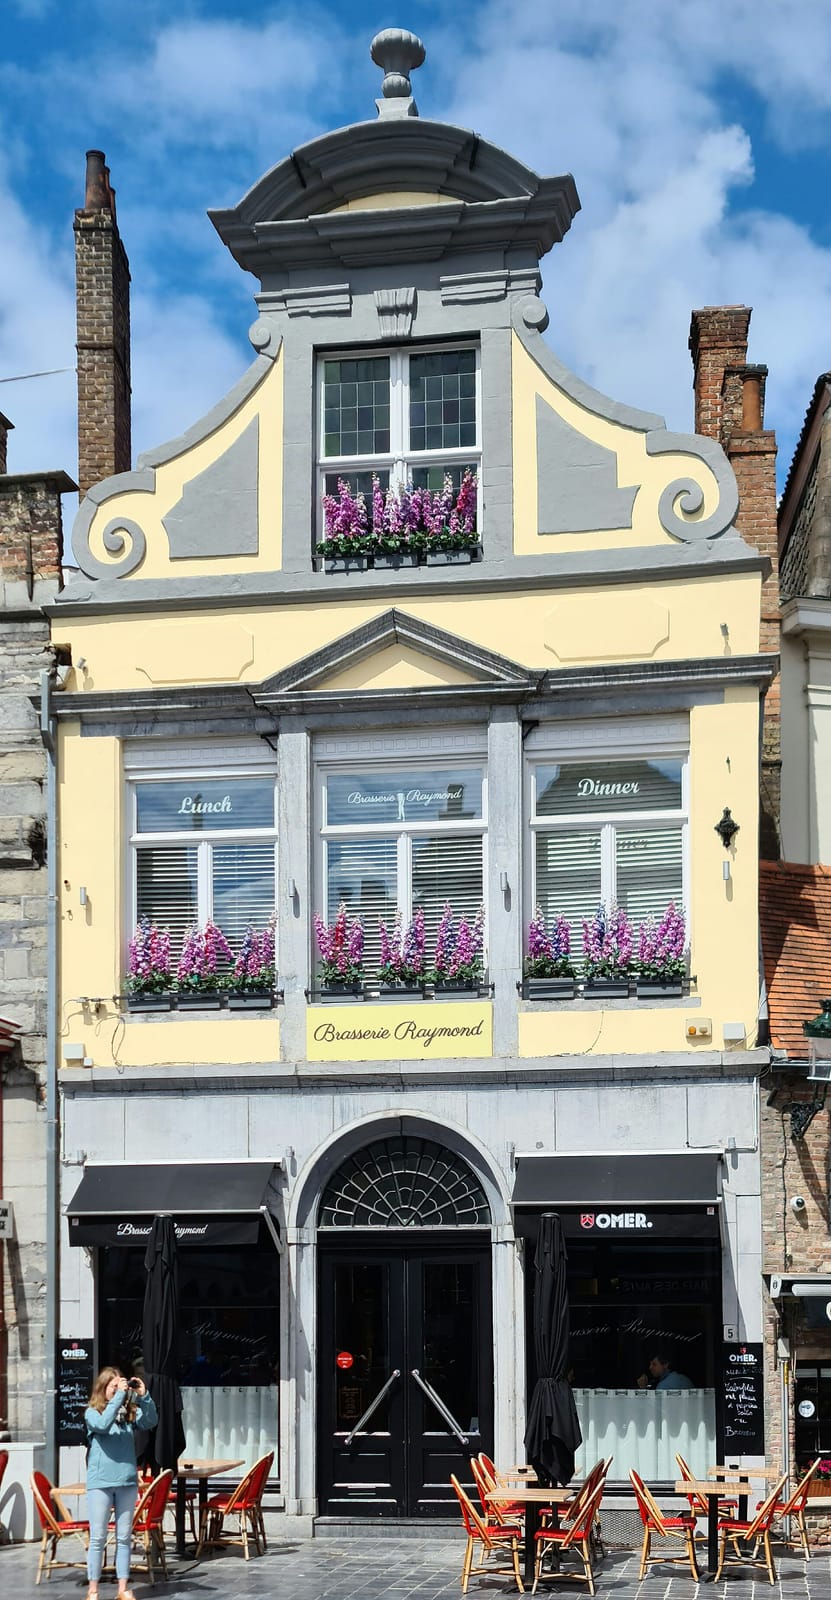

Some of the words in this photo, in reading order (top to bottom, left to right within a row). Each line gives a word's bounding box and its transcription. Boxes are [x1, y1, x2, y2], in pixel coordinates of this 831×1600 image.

[347, 791, 396, 804] Brasserie
[406, 788, 463, 806] Raymond
[577, 778, 640, 797] Dinner
[178, 795, 233, 815] Lunch
[313, 1023, 391, 1043] Brasserie
[394, 1019, 484, 1048] Raymond
[116, 1222, 153, 1236] Brasse
[174, 1222, 209, 1239] aymond
[616, 1318, 703, 1343] Raymond
[727, 1328, 734, 1338] 5
